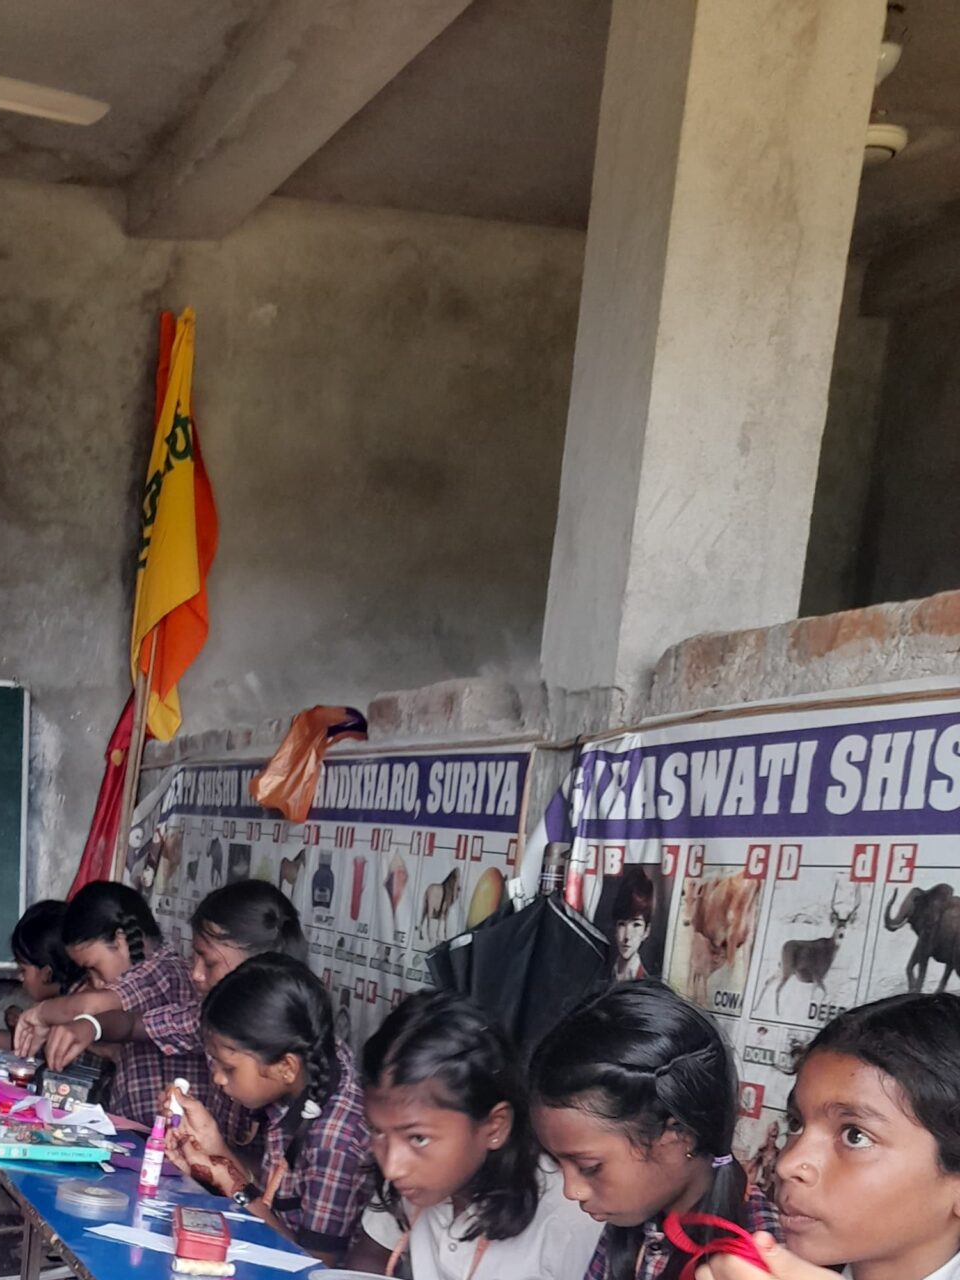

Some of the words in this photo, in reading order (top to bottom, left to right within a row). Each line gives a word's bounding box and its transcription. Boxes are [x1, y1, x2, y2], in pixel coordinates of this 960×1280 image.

[197, 768, 240, 807] SHISHU
[311, 761, 421, 820] ANDKHARO,
[426, 760, 520, 816] SURIYA
[604, 847, 622, 875] B
[688, 845, 704, 877] C
[779, 846, 801, 879] D
[854, 844, 874, 878] d
[889, 845, 914, 881] E
[714, 990, 739, 1008] COW
